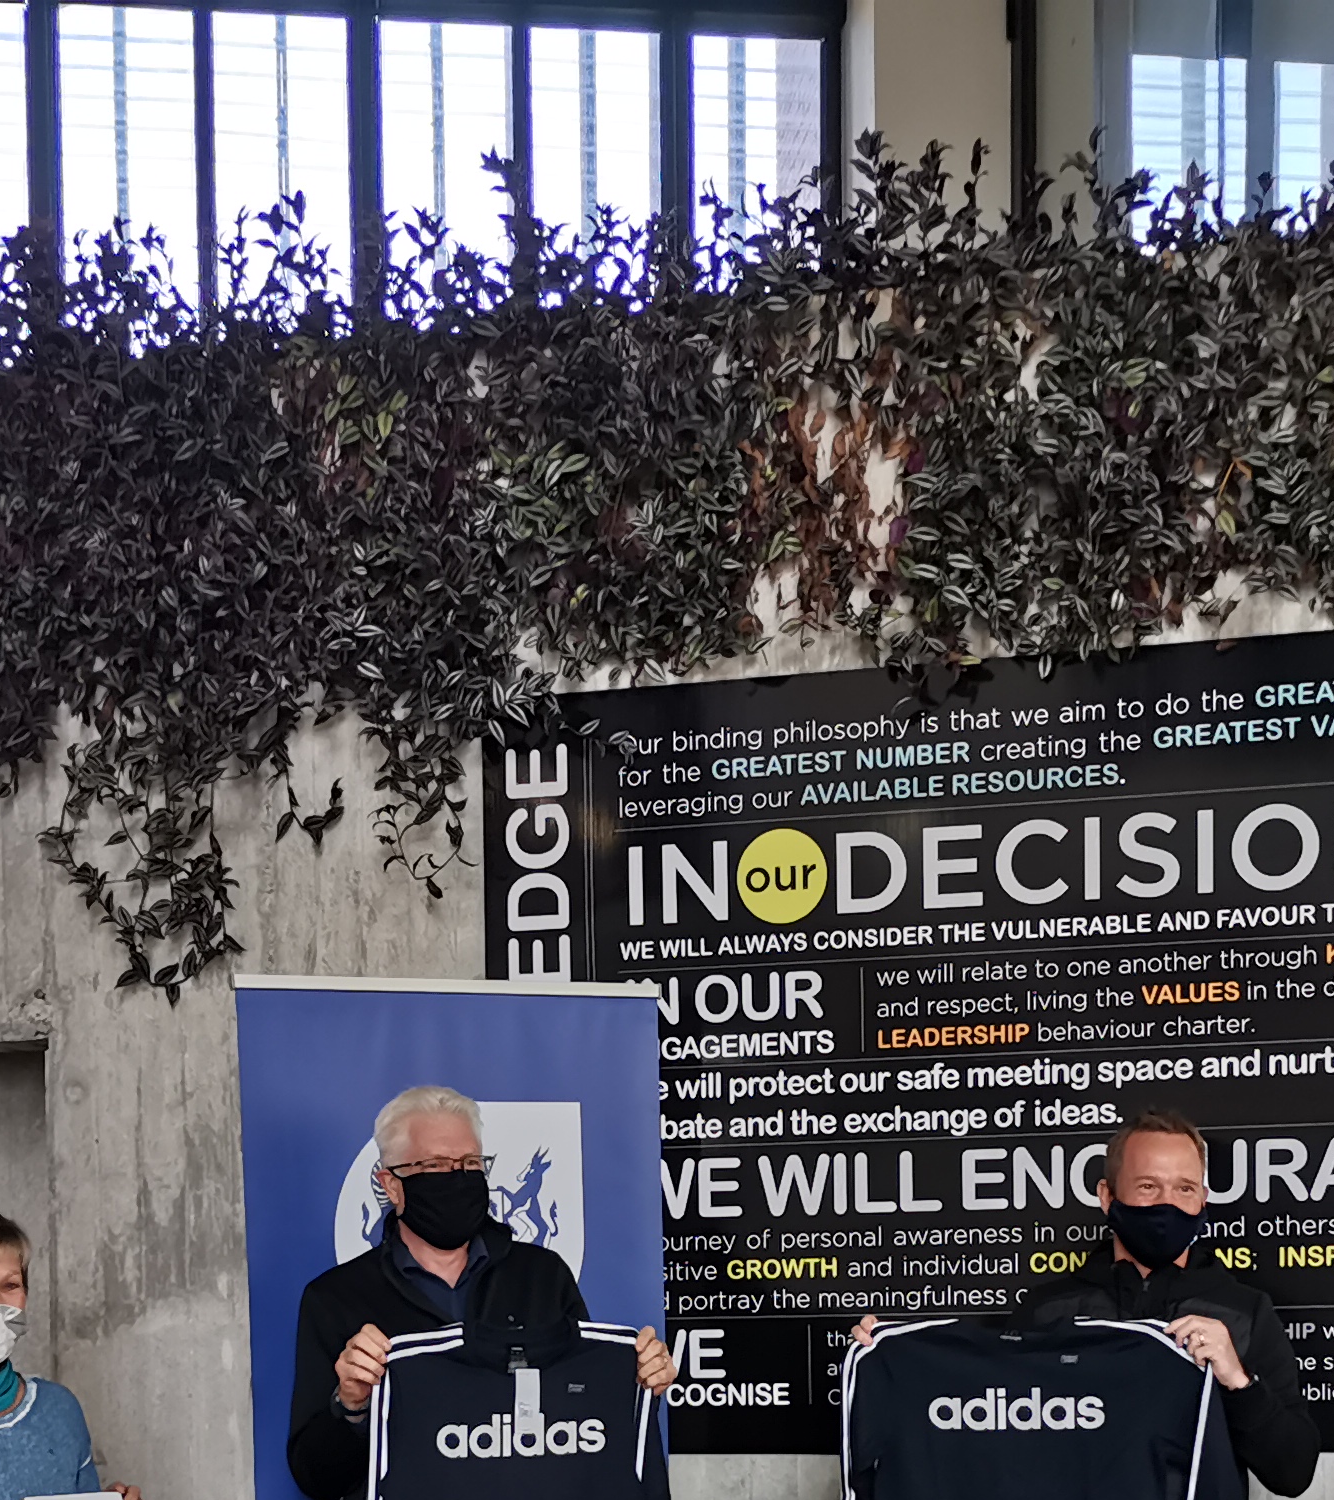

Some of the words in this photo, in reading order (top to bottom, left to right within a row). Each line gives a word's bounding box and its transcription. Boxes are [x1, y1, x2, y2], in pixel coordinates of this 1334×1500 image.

[673, 727, 762, 752] binding
[774, 715, 910, 748] philosophy
[921, 712, 938, 733] is
[950, 708, 1001, 731] that
[1011, 708, 1049, 726] we
[1059, 700, 1105, 723] aim
[1117, 698, 1144, 719] to
[1155, 693, 1189, 716] do
[1201, 689, 1244, 712] the
[618, 766, 652, 787] for
[662, 762, 701, 784] the
[712, 750, 847, 780] GREATEST
[856, 742, 970, 770] NUMBER
[981, 735, 1086, 761] creating
[1099, 730, 1141, 753] the
[1153, 717, 1301, 748] GREATEST
[619, 791, 743, 818] leveraging
[752, 791, 793, 809] our
[801, 775, 944, 806] AVAILABLE
[952, 763, 1126, 795] RESOURCES.
[628, 840, 728, 926] IN
[746, 864, 816, 893] our
[620, 941, 654, 960] WE
[659, 938, 713, 958] WILL
[718, 932, 807, 955] ALWAYS
[813, 926, 933, 950] CONSIDER
[938, 923, 986, 943] THE
[991, 913, 1152, 940] VULNERABLE
[1157, 911, 1210, 932] AND
[1217, 905, 1316, 929] FAVOUR
[877, 970, 909, 986] we
[917, 963, 953, 984] will
[962, 961, 1027, 982] relate
[1035, 959, 1059, 978] to
[1066, 955, 1112, 976] one
[1118, 951, 1212, 974] another
[1219, 946, 1318, 974] through
[695, 971, 823, 1023] OUR
[877, 997, 918, 1017] and
[927, 993, 1018, 1017] respect,
[1027, 990, 1087, 1012] living
[1096, 987, 1134, 1007] the
[1142, 981, 1240, 1005] VALUES
[1247, 985, 1267, 1000] in
[1276, 978, 1315, 999] the
[661, 1030, 834, 1060] GAGEMENTS
[878, 1023, 1030, 1048] LEADERSHIP
[1038, 1019, 1155, 1042] behaviour
[1163, 1015, 1255, 1036] charter.
[675, 1072, 721, 1099] will
[729, 1068, 835, 1104] protect
[840, 1071, 891, 1093] our
[897, 1062, 960, 1091] safe
[967, 1058, 1090, 1090] meeting
[1098, 1058, 1193, 1088] space
[1200, 1049, 1260, 1078] and
[660, 1113, 723, 1140] bate
[729, 1109, 783, 1137] and
[790, 1109, 837, 1135] the
[844, 1105, 987, 1138] exchange
[994, 1100, 1026, 1128] of
[1034, 1099, 1123, 1126] ideas.
[758, 1151, 943, 1217] WILL
[746, 1229, 771, 1249] of
[781, 1226, 882, 1252] personal
[894, 1227, 1022, 1246] awareness
[1034, 1221, 1054, 1242] in
[1201, 1216, 1245, 1238] and
[663, 1261, 718, 1282] itive
[727, 1257, 837, 1280] GROWTH
[848, 1256, 892, 1277] and
[904, 1253, 1018, 1276] individual
[679, 1291, 764, 1314] portray
[773, 1288, 810, 1309] the
[819, 1285, 1007, 1310] meaningfulness
[666, 1382, 790, 1408] COGNISE
[928, 1387, 1105, 1431] adidas
[436, 1413, 606, 1459] adidas
